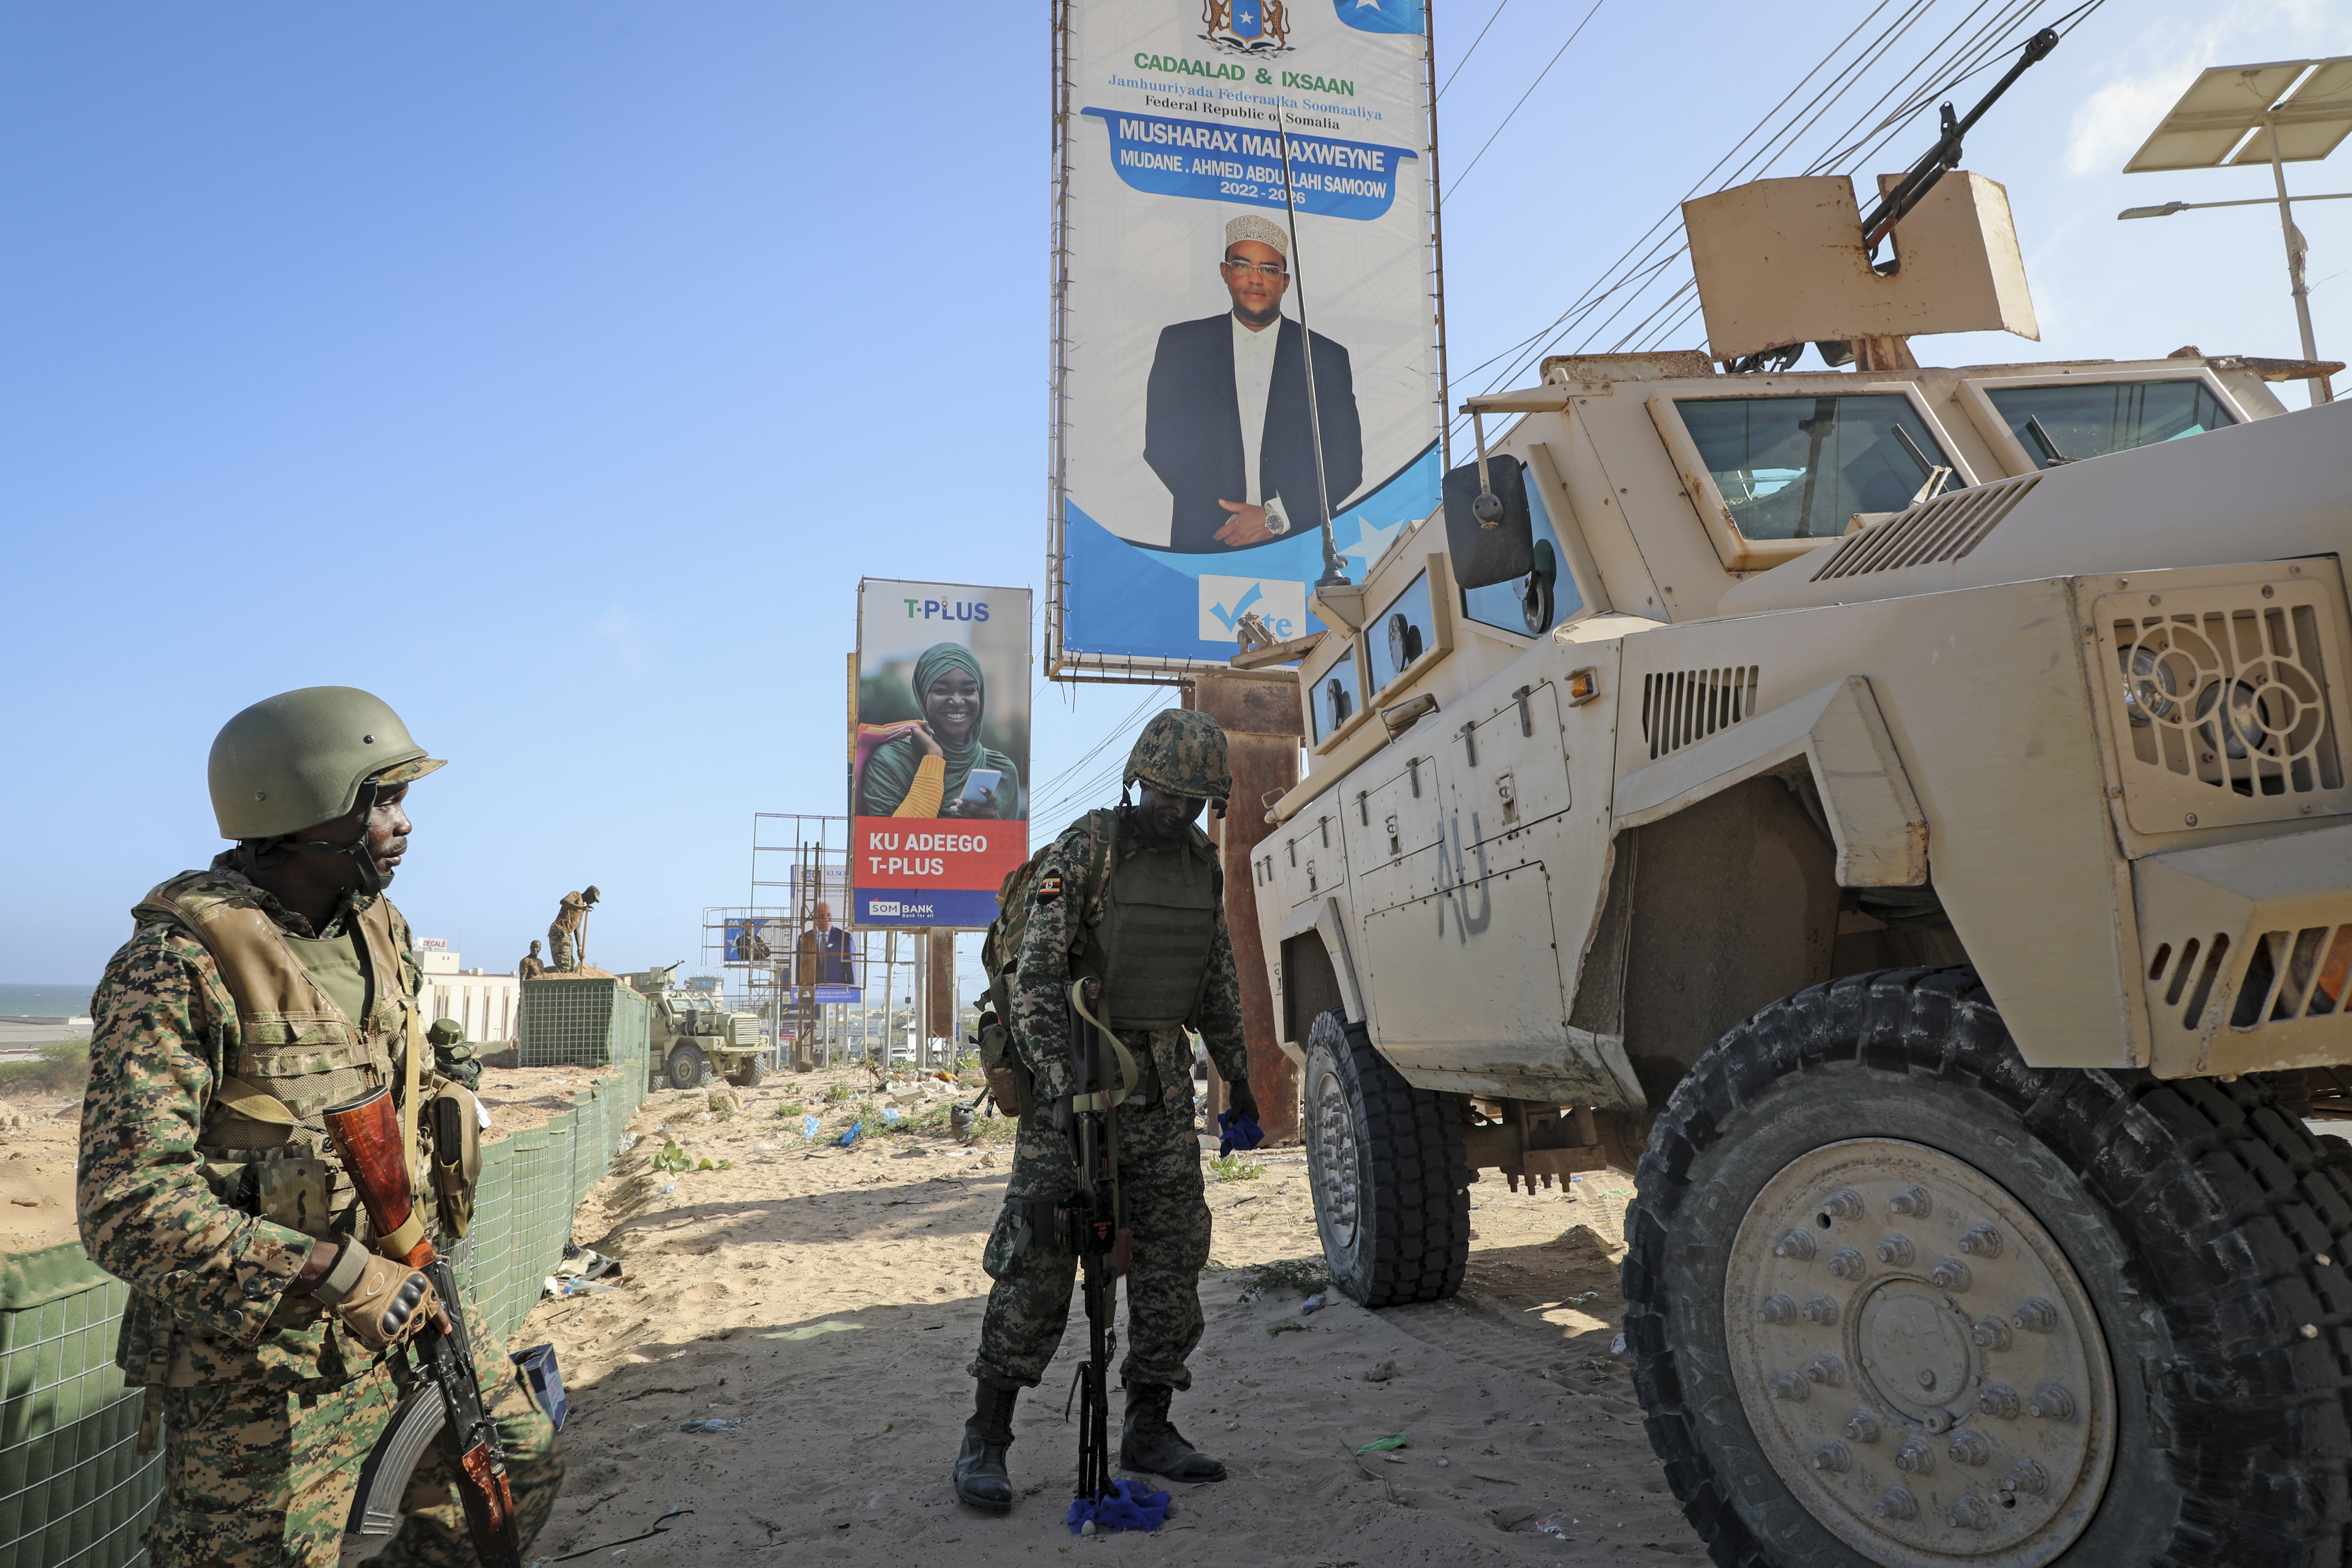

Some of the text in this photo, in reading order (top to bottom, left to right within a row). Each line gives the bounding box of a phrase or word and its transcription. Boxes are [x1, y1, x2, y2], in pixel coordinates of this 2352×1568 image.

[1134, 52, 1354, 96] CADAALAD & IXSAAN
[1109, 75, 1382, 121] Jamhuuriyada Federaalka Soomaaliya
[1145, 95, 1340, 130] Federal Republic o Somalia
[1120, 118, 1238, 154] MUSHARAX
[1192, 159, 1243, 180] AHMED
[1246, 165, 1320, 191] ABDULAHI
[1324, 176, 1387, 199] SAMOOW
[1220, 181, 1257, 198] 2022
[869, 832, 987, 853] KU ADEEGO
[869, 857, 944, 875] T-PLUS
[1437, 811, 1491, 944] AU
